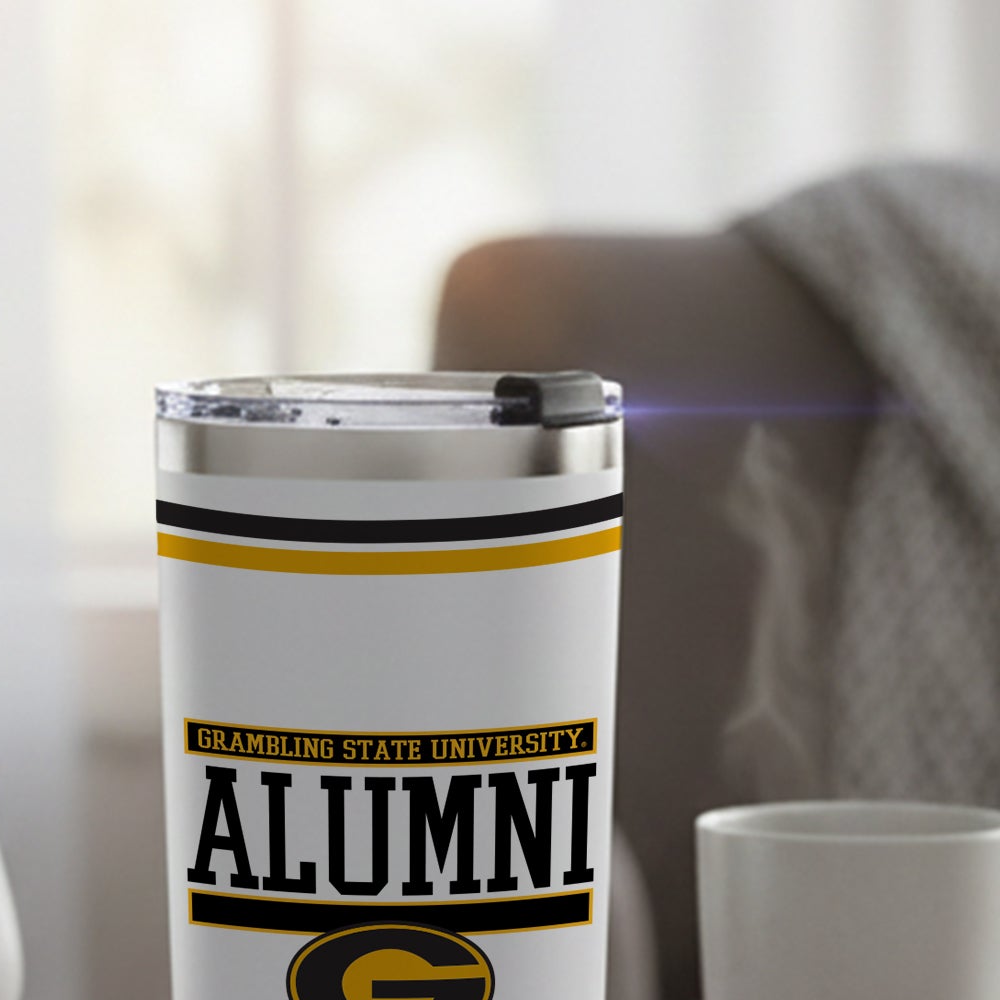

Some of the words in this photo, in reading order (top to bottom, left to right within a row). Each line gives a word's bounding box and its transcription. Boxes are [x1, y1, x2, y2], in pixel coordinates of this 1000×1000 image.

[197, 728, 334, 760] GRAMBLING
[343, 738, 421, 761] STATE
[187, 763, 597, 896] ALUMNI
